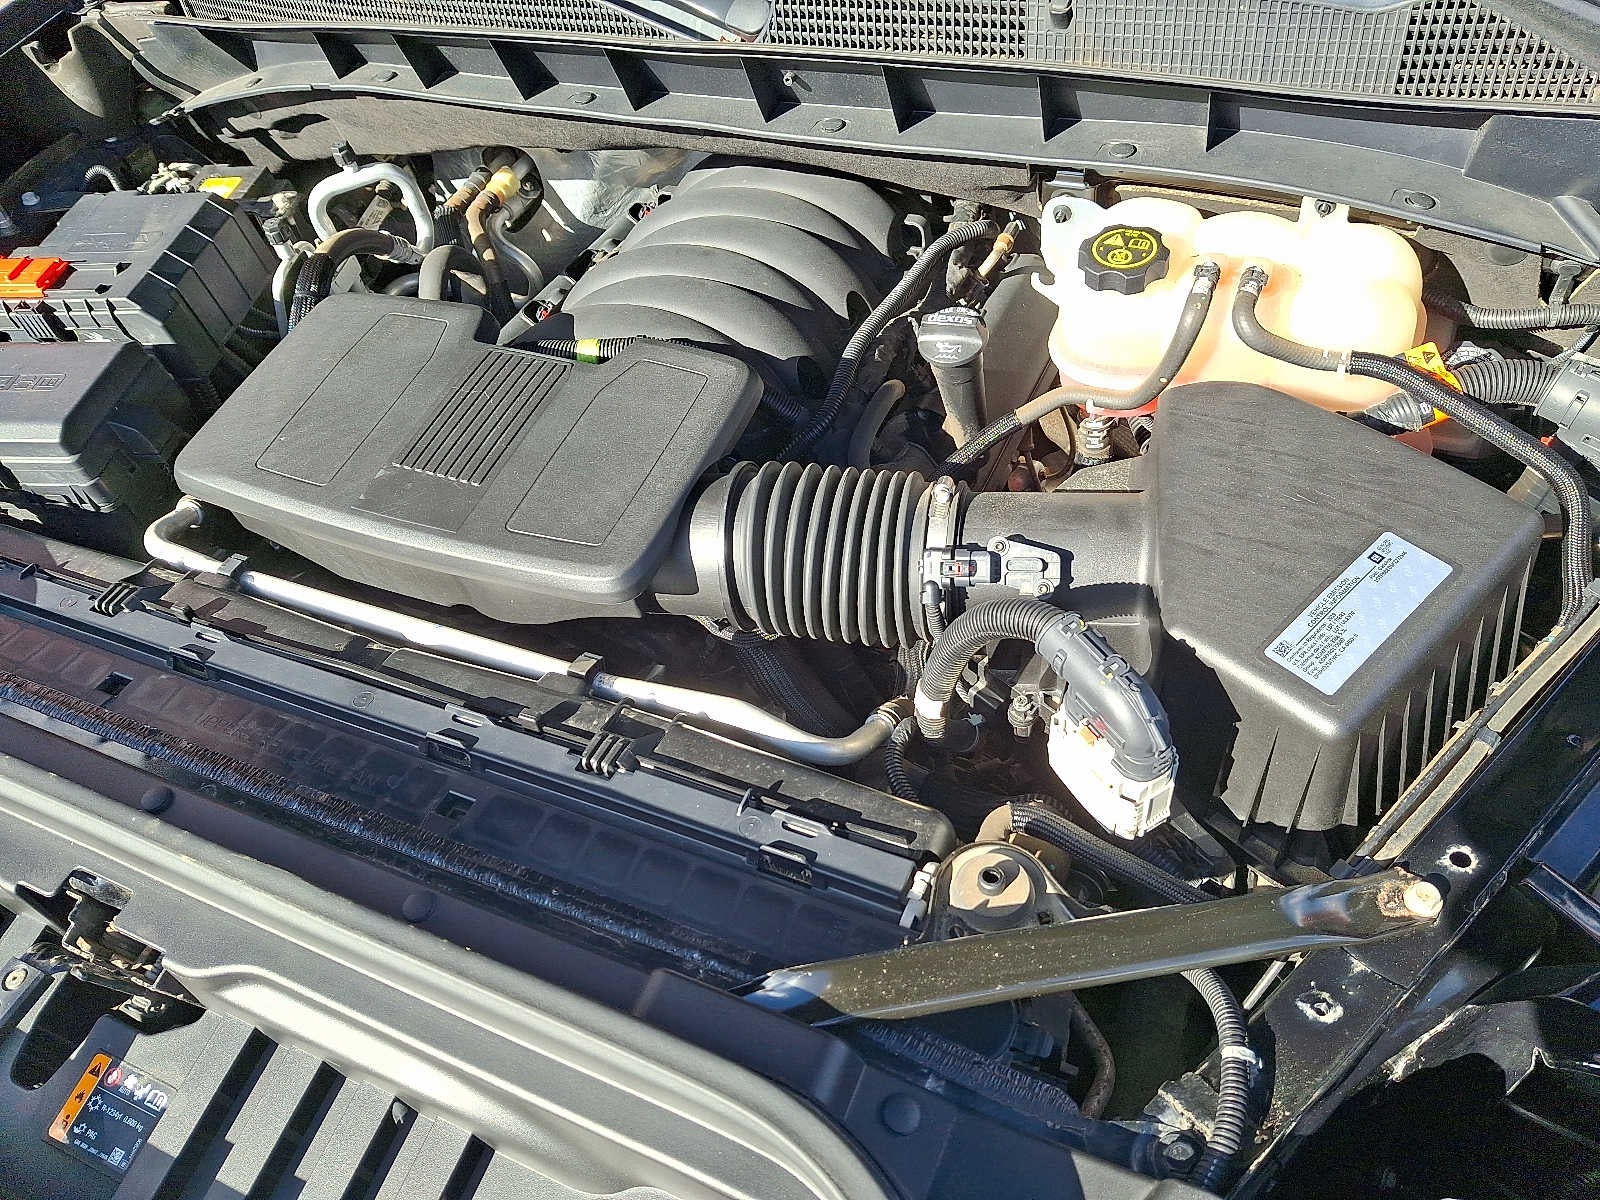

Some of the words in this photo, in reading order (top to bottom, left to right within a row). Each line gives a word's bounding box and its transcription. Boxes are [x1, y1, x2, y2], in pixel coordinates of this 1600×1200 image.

[928, 313, 973, 325] dexos
[1306, 604, 1331, 627] CONTROL
[1327, 575, 1360, 606] INFORMATION
[1307, 597, 1330, 618] VEHICLE
[1325, 576, 1350, 599] EMISSION
[117, 1086, 130, 1096] AUTO
[100, 1105, 123, 1121] R-1234yf
[136, 1122, 144, 1132] kg
[85, 1128, 98, 1140] PAG
